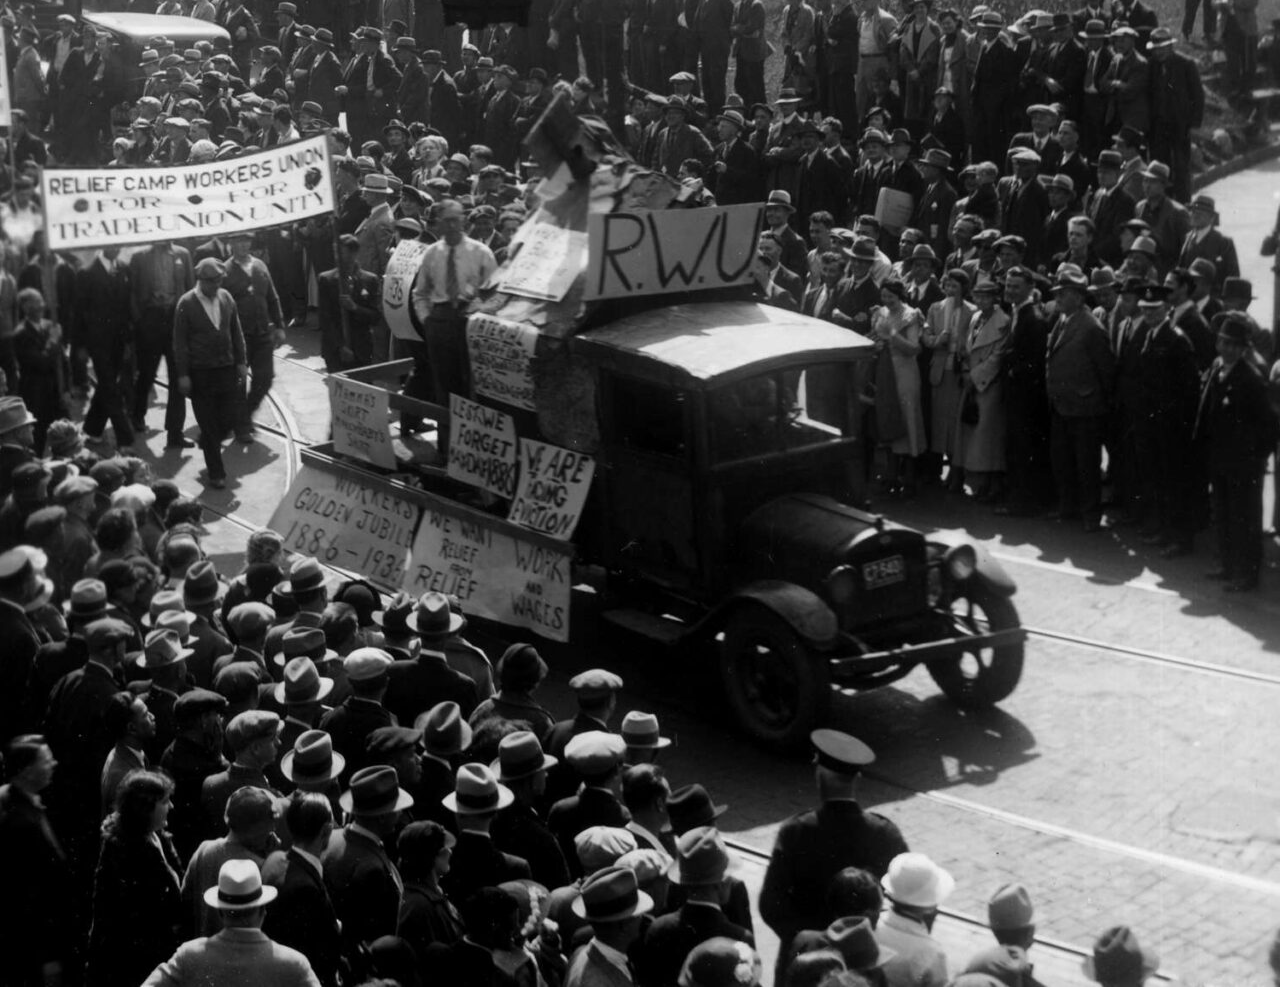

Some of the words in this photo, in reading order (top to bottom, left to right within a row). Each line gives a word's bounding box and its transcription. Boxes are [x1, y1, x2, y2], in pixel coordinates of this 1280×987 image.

[48, 176, 118, 196] RELIEF
[122, 175, 177, 192] CAMP
[183, 160, 272, 190] WORKERS
[278, 144, 325, 174] UNION
[51, 216, 152, 241] TRADE
[154, 208, 245, 234] UNION
[250, 191, 326, 221] UNITY
[96, 195, 161, 213] FOR
[227, 181, 288, 204] FOR
[598, 207, 764, 296] R.W.U.
[480, 407, 505, 432] WE
[457, 423, 514, 458] FORGET
[525, 443, 546, 472] WE
[543, 450, 589, 484] ARE
[335, 474, 414, 520] WORKERS
[293, 486, 354, 524] GOLDEN
[356, 509, 414, 548] JUBILE
[429, 511, 451, 534] WE
[460, 520, 493, 549] WANT
[438, 538, 479, 564] RELIEF
[514, 539, 564, 584] WORK
[414, 564, 479, 601] RELIEF
[526, 581, 543, 595] AND
[510, 591, 564, 630] WAGES
